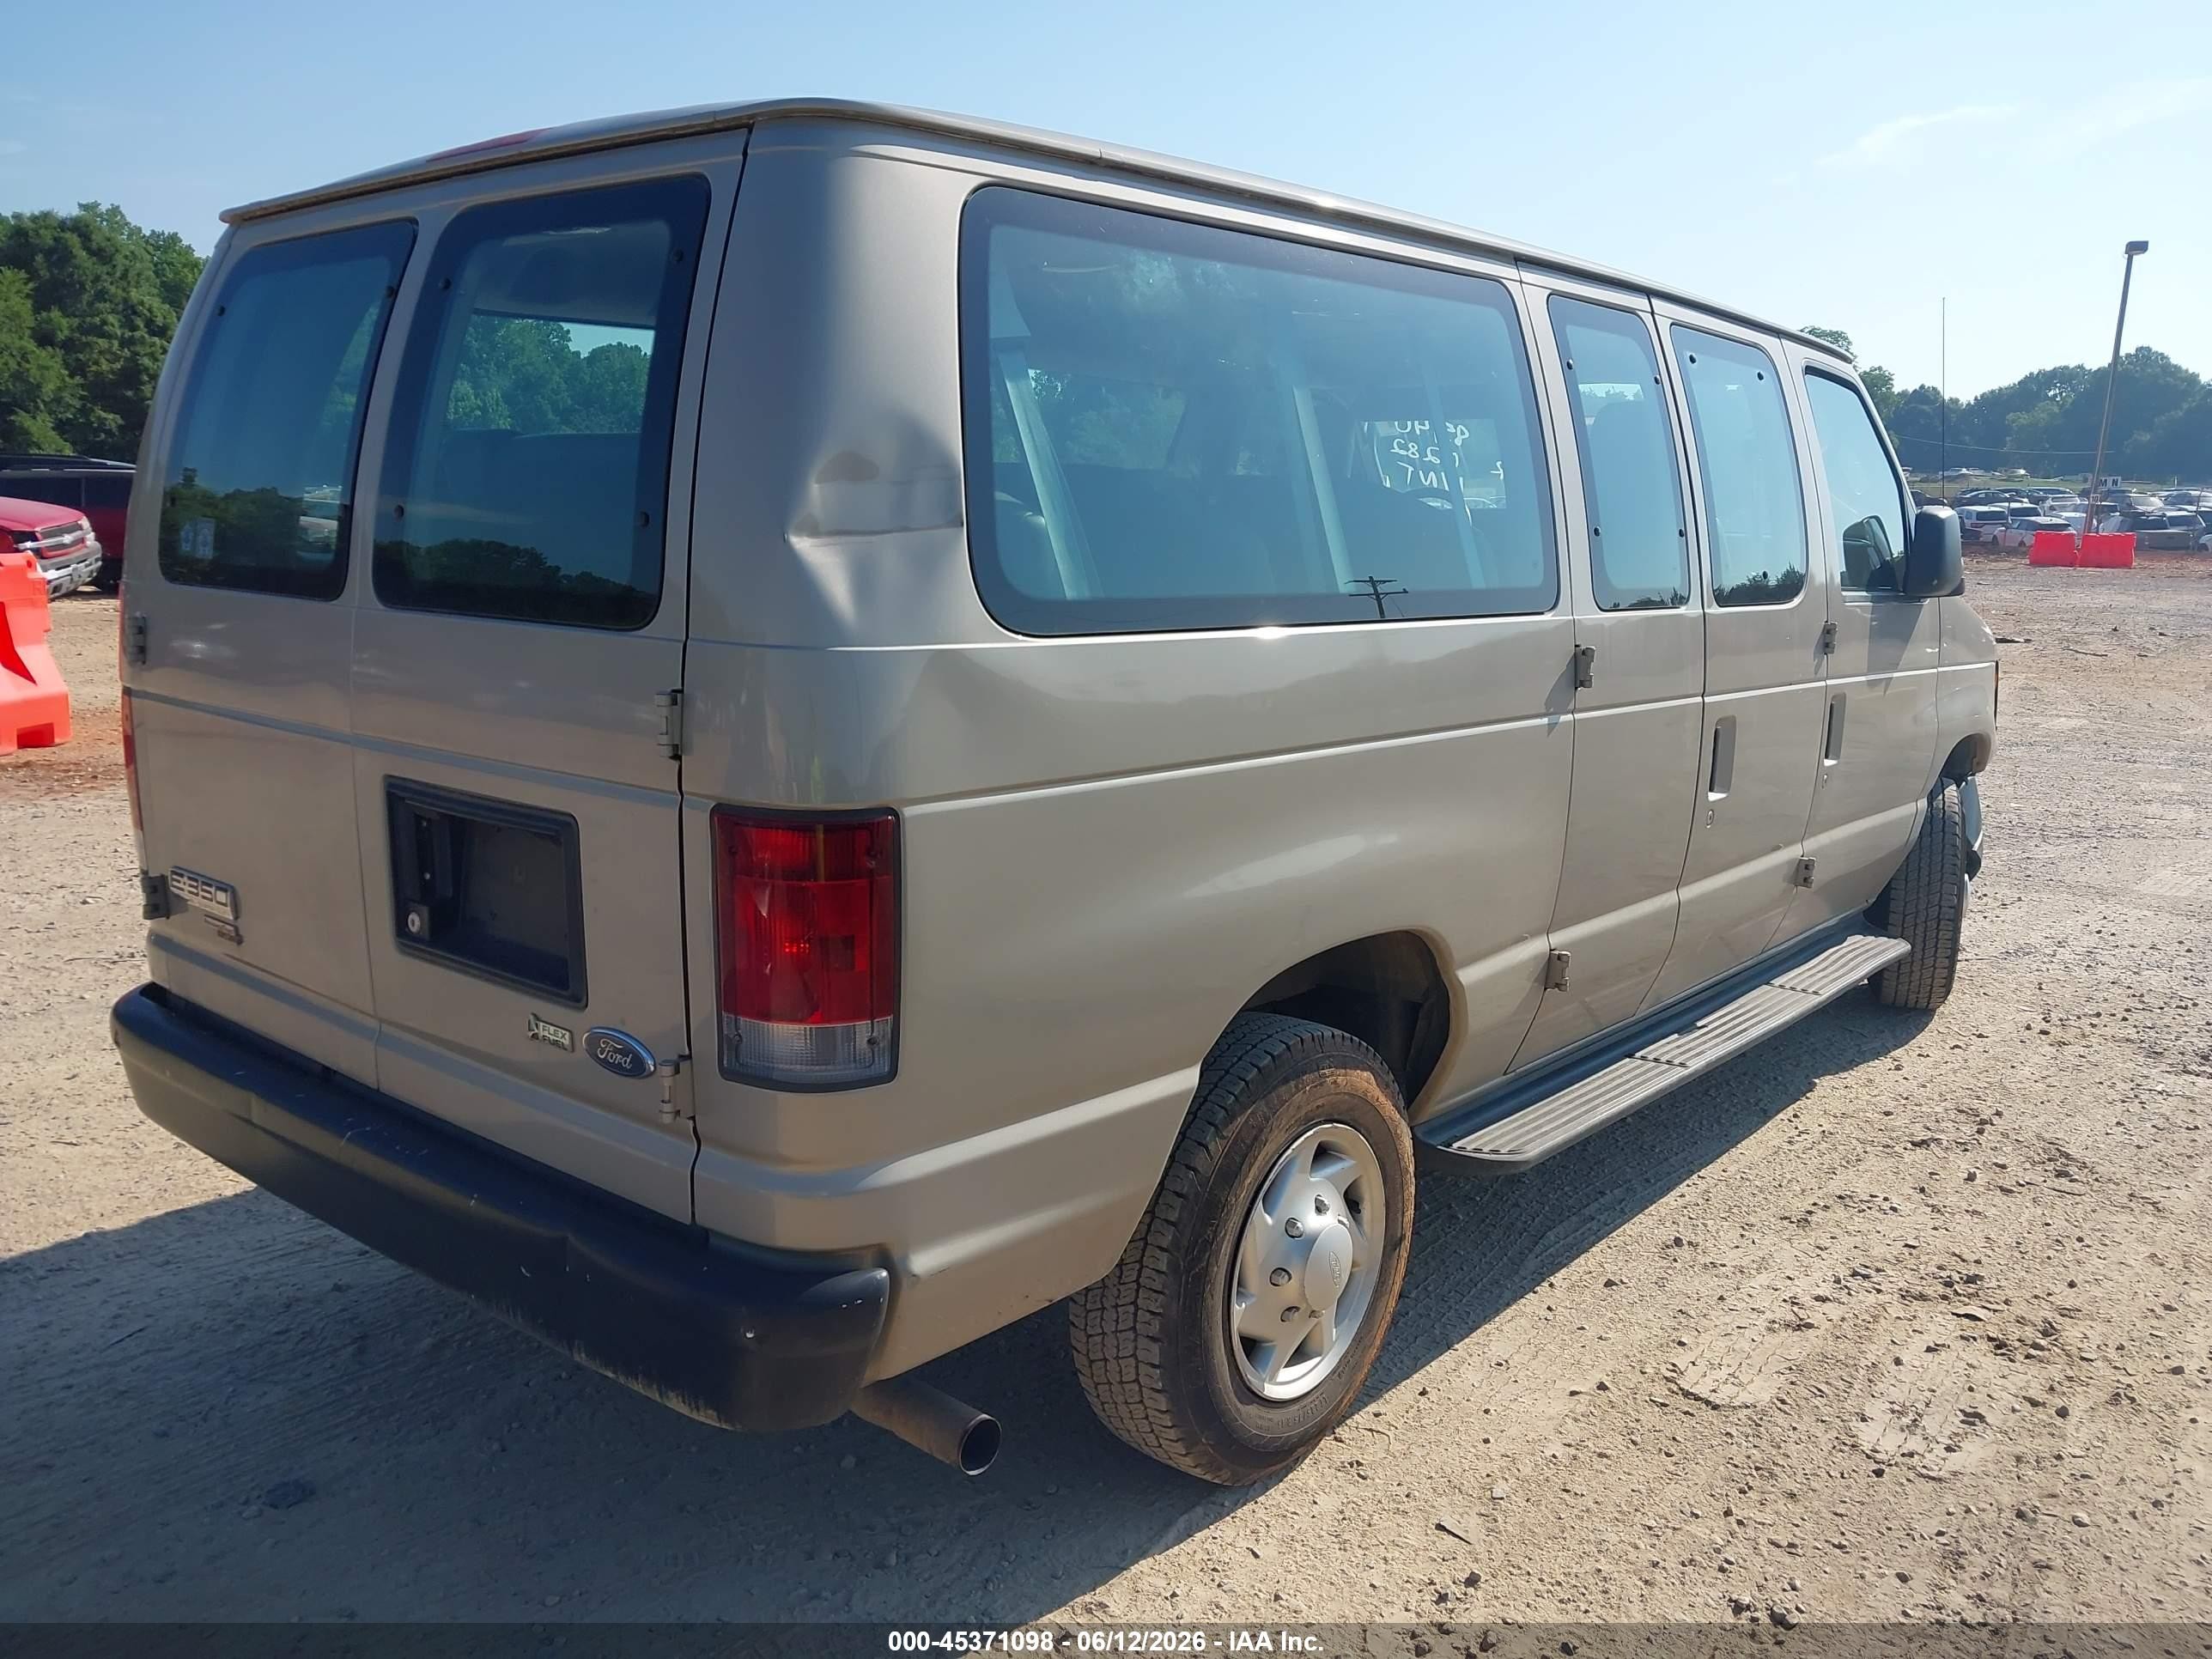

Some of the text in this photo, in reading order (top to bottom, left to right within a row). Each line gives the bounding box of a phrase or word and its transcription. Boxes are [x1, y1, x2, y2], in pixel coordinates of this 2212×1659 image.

[541, 1024, 568, 1042] FLEX
[542, 1036, 568, 1051] FUEL
[597, 1038, 633, 1069] Ford
